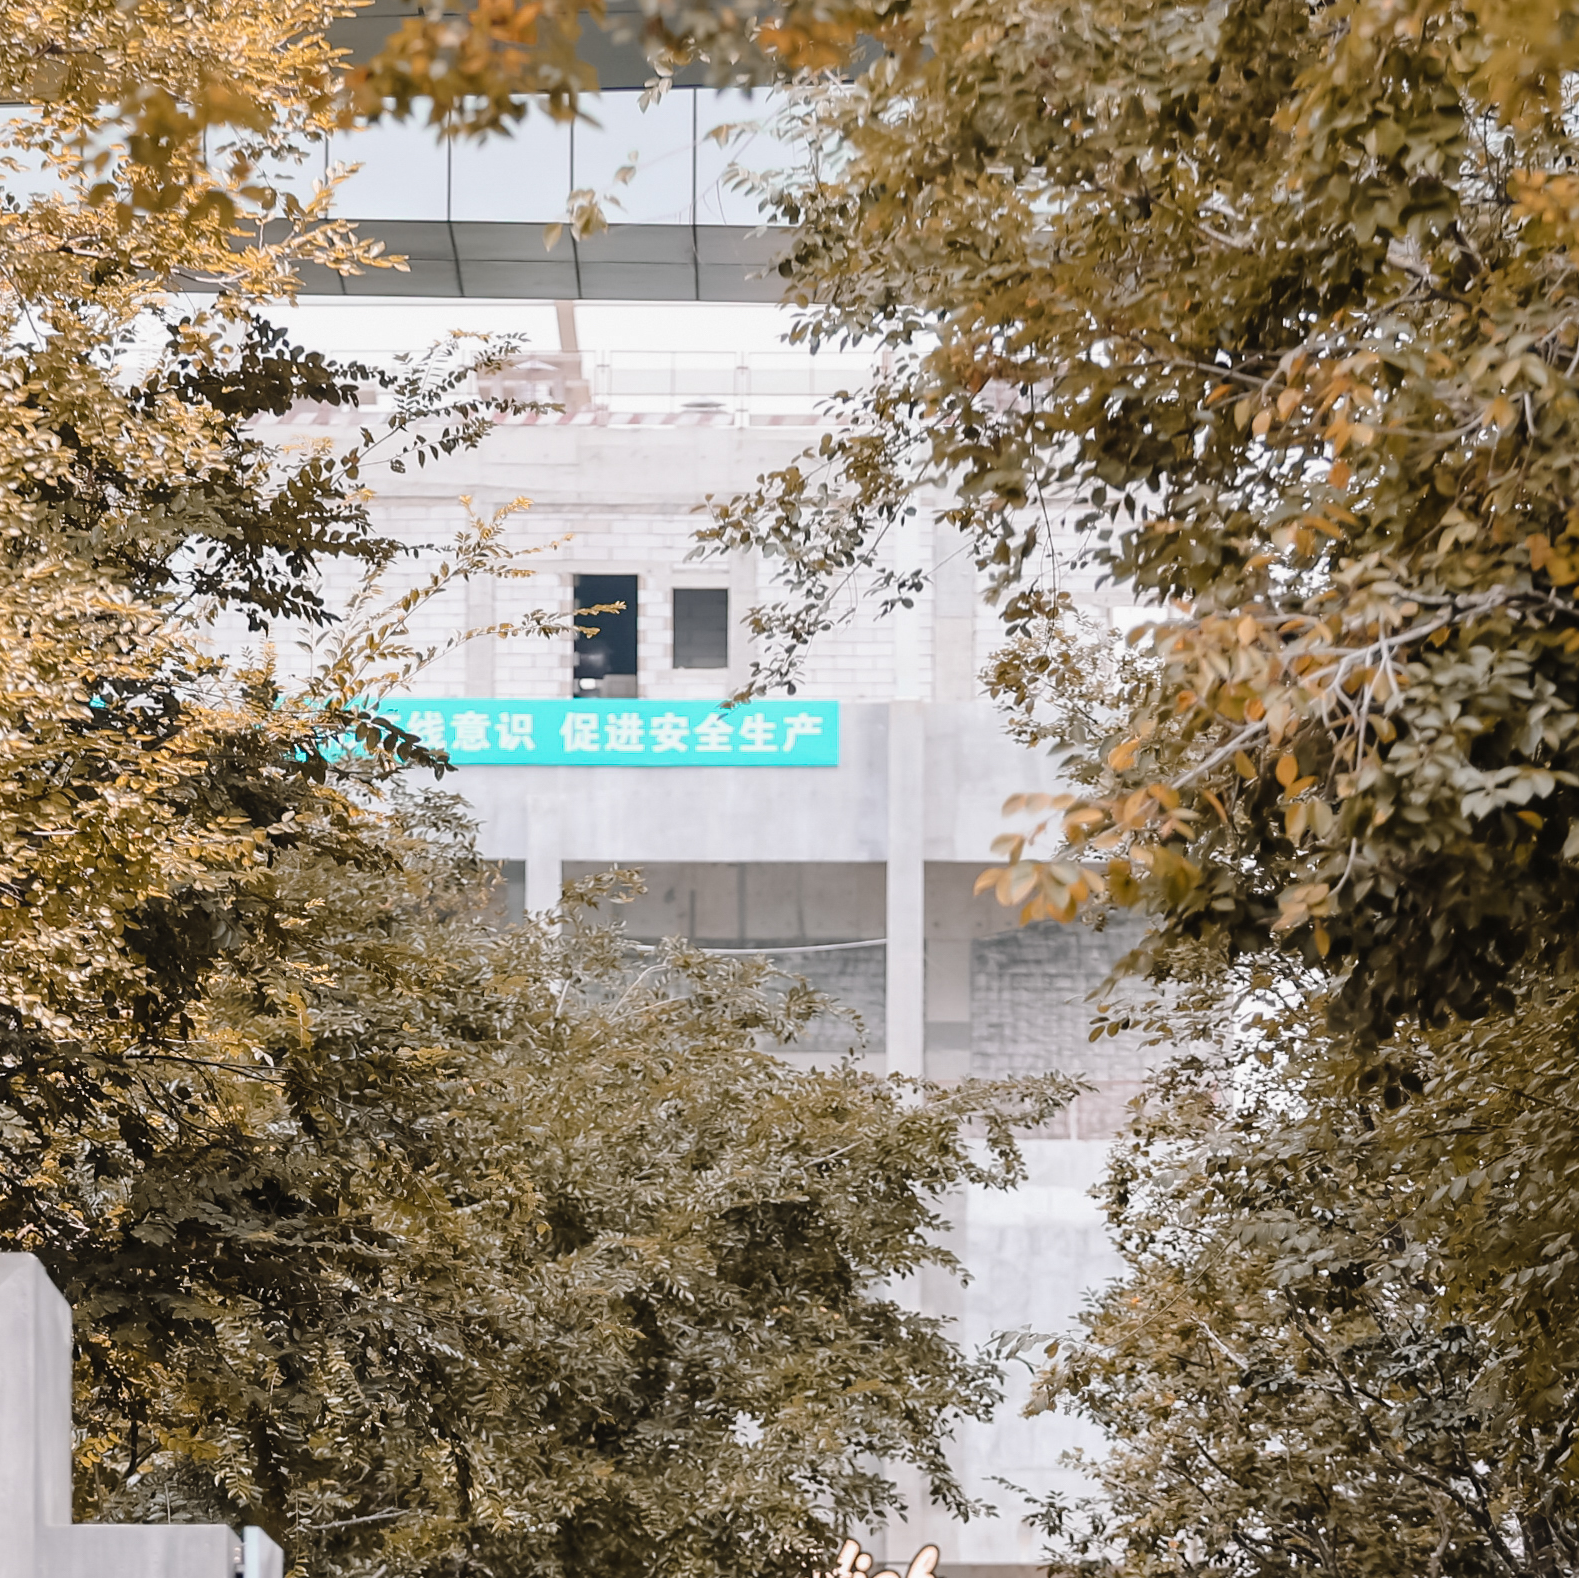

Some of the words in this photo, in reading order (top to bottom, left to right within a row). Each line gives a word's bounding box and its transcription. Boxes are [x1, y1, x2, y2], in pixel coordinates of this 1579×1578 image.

[382, 710, 536, 751] 线意识
[560, 711, 822, 752] 促进安全生产
